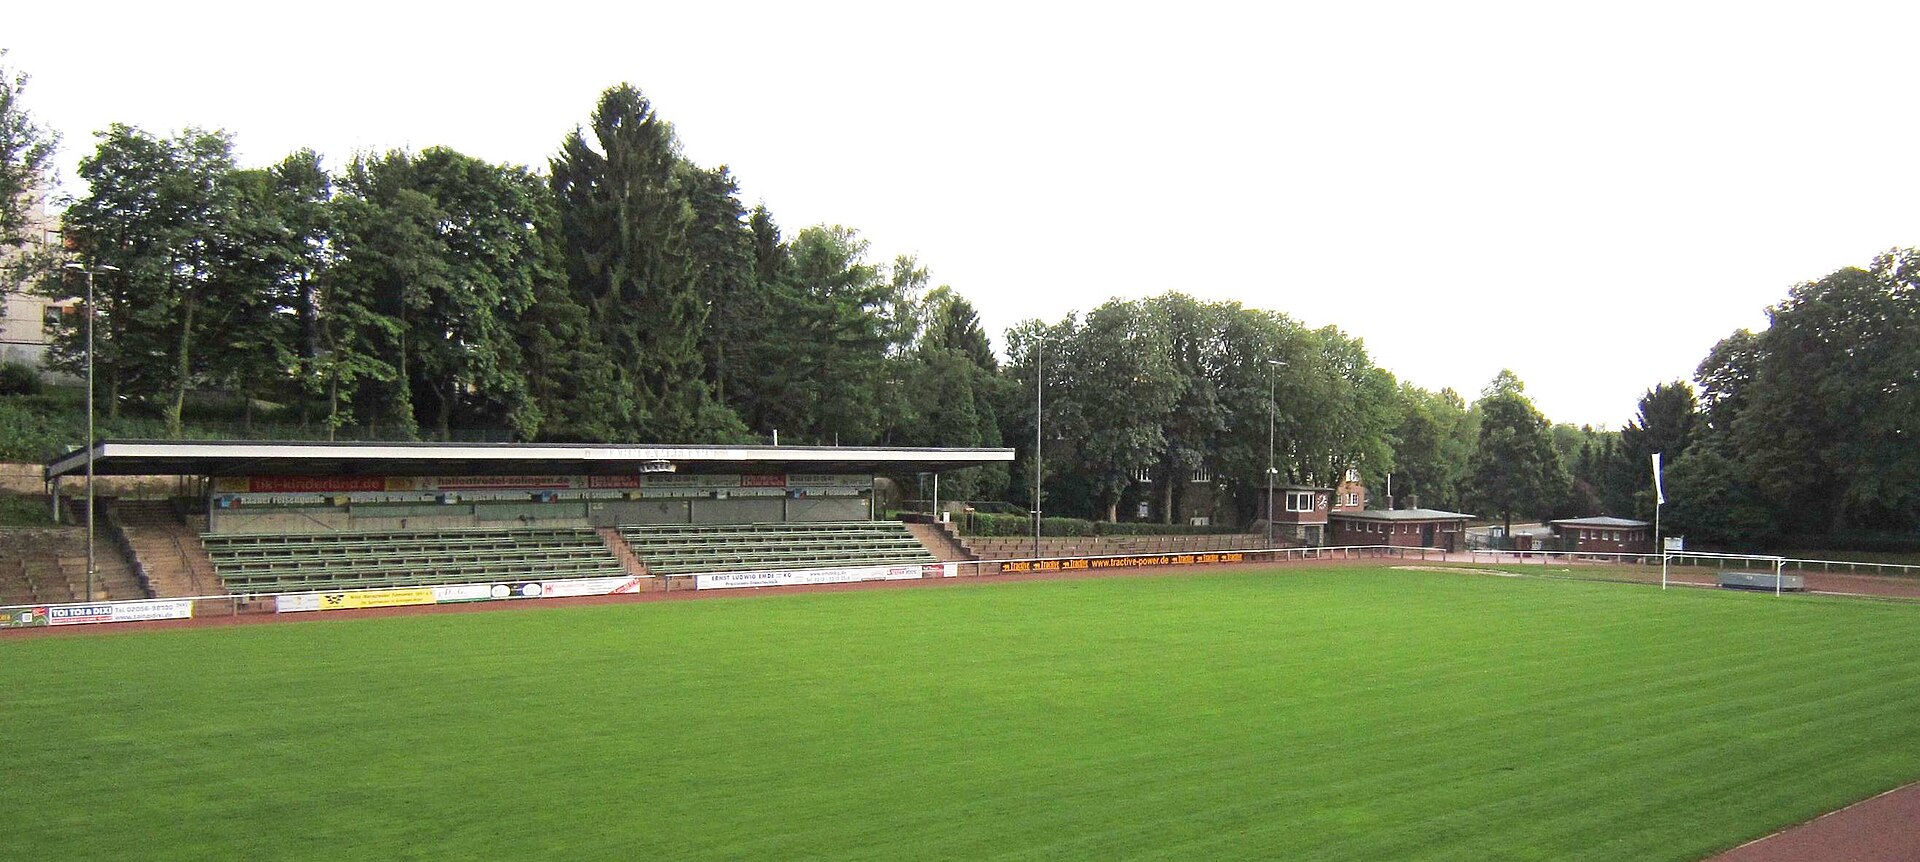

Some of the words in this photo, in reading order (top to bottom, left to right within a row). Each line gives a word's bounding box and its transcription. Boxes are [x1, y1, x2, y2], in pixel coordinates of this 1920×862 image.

[1091, 555, 1169, 568] www.tractive-power.de
[732, 573, 757, 581] LUDWIG
[759, 572, 775, 580] EMDE
[52, 608, 69, 618] TOI
[70, 607, 86, 617] TOI
[93, 606, 112, 616] DIXI
